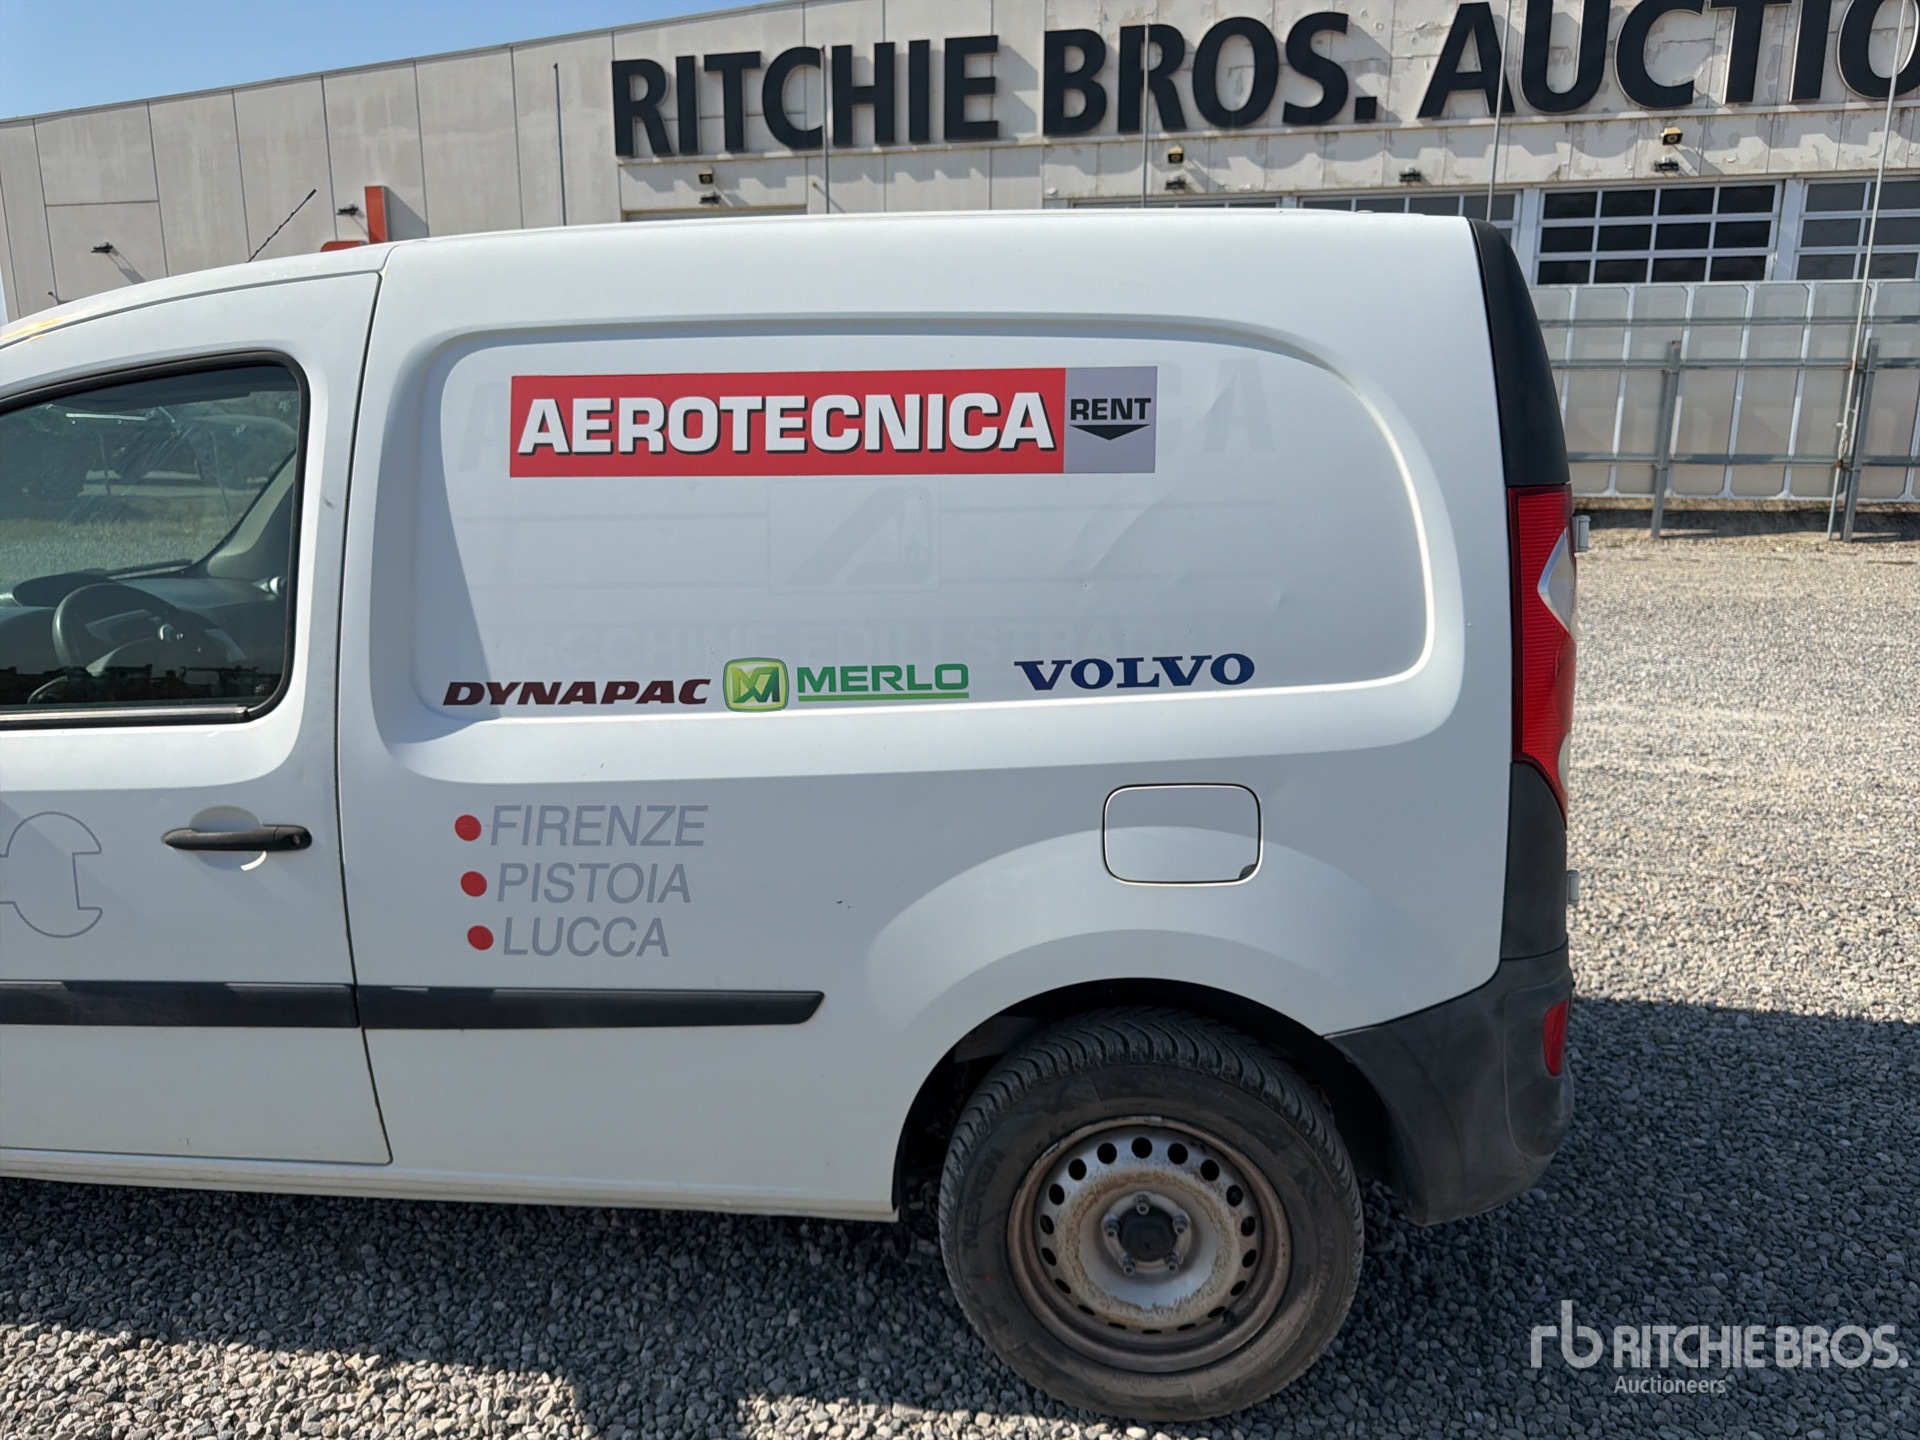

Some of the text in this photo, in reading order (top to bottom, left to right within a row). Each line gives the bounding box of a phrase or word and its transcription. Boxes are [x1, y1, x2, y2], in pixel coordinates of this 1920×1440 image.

[611, 35, 1000, 157] RITCHIE
[1042, 12, 1378, 136] BROS.
[517, 392, 1056, 456] AEROTECNICA
[1069, 397, 1152, 421] RENT
[442, 677, 713, 707] DYNAPAC
[797, 663, 970, 694] MERLO
[1013, 652, 1256, 692] VOLVO
[490, 804, 709, 847] FIRENZE
[496, 862, 692, 904] PISTOIA
[502, 916, 670, 957] LUCCA
